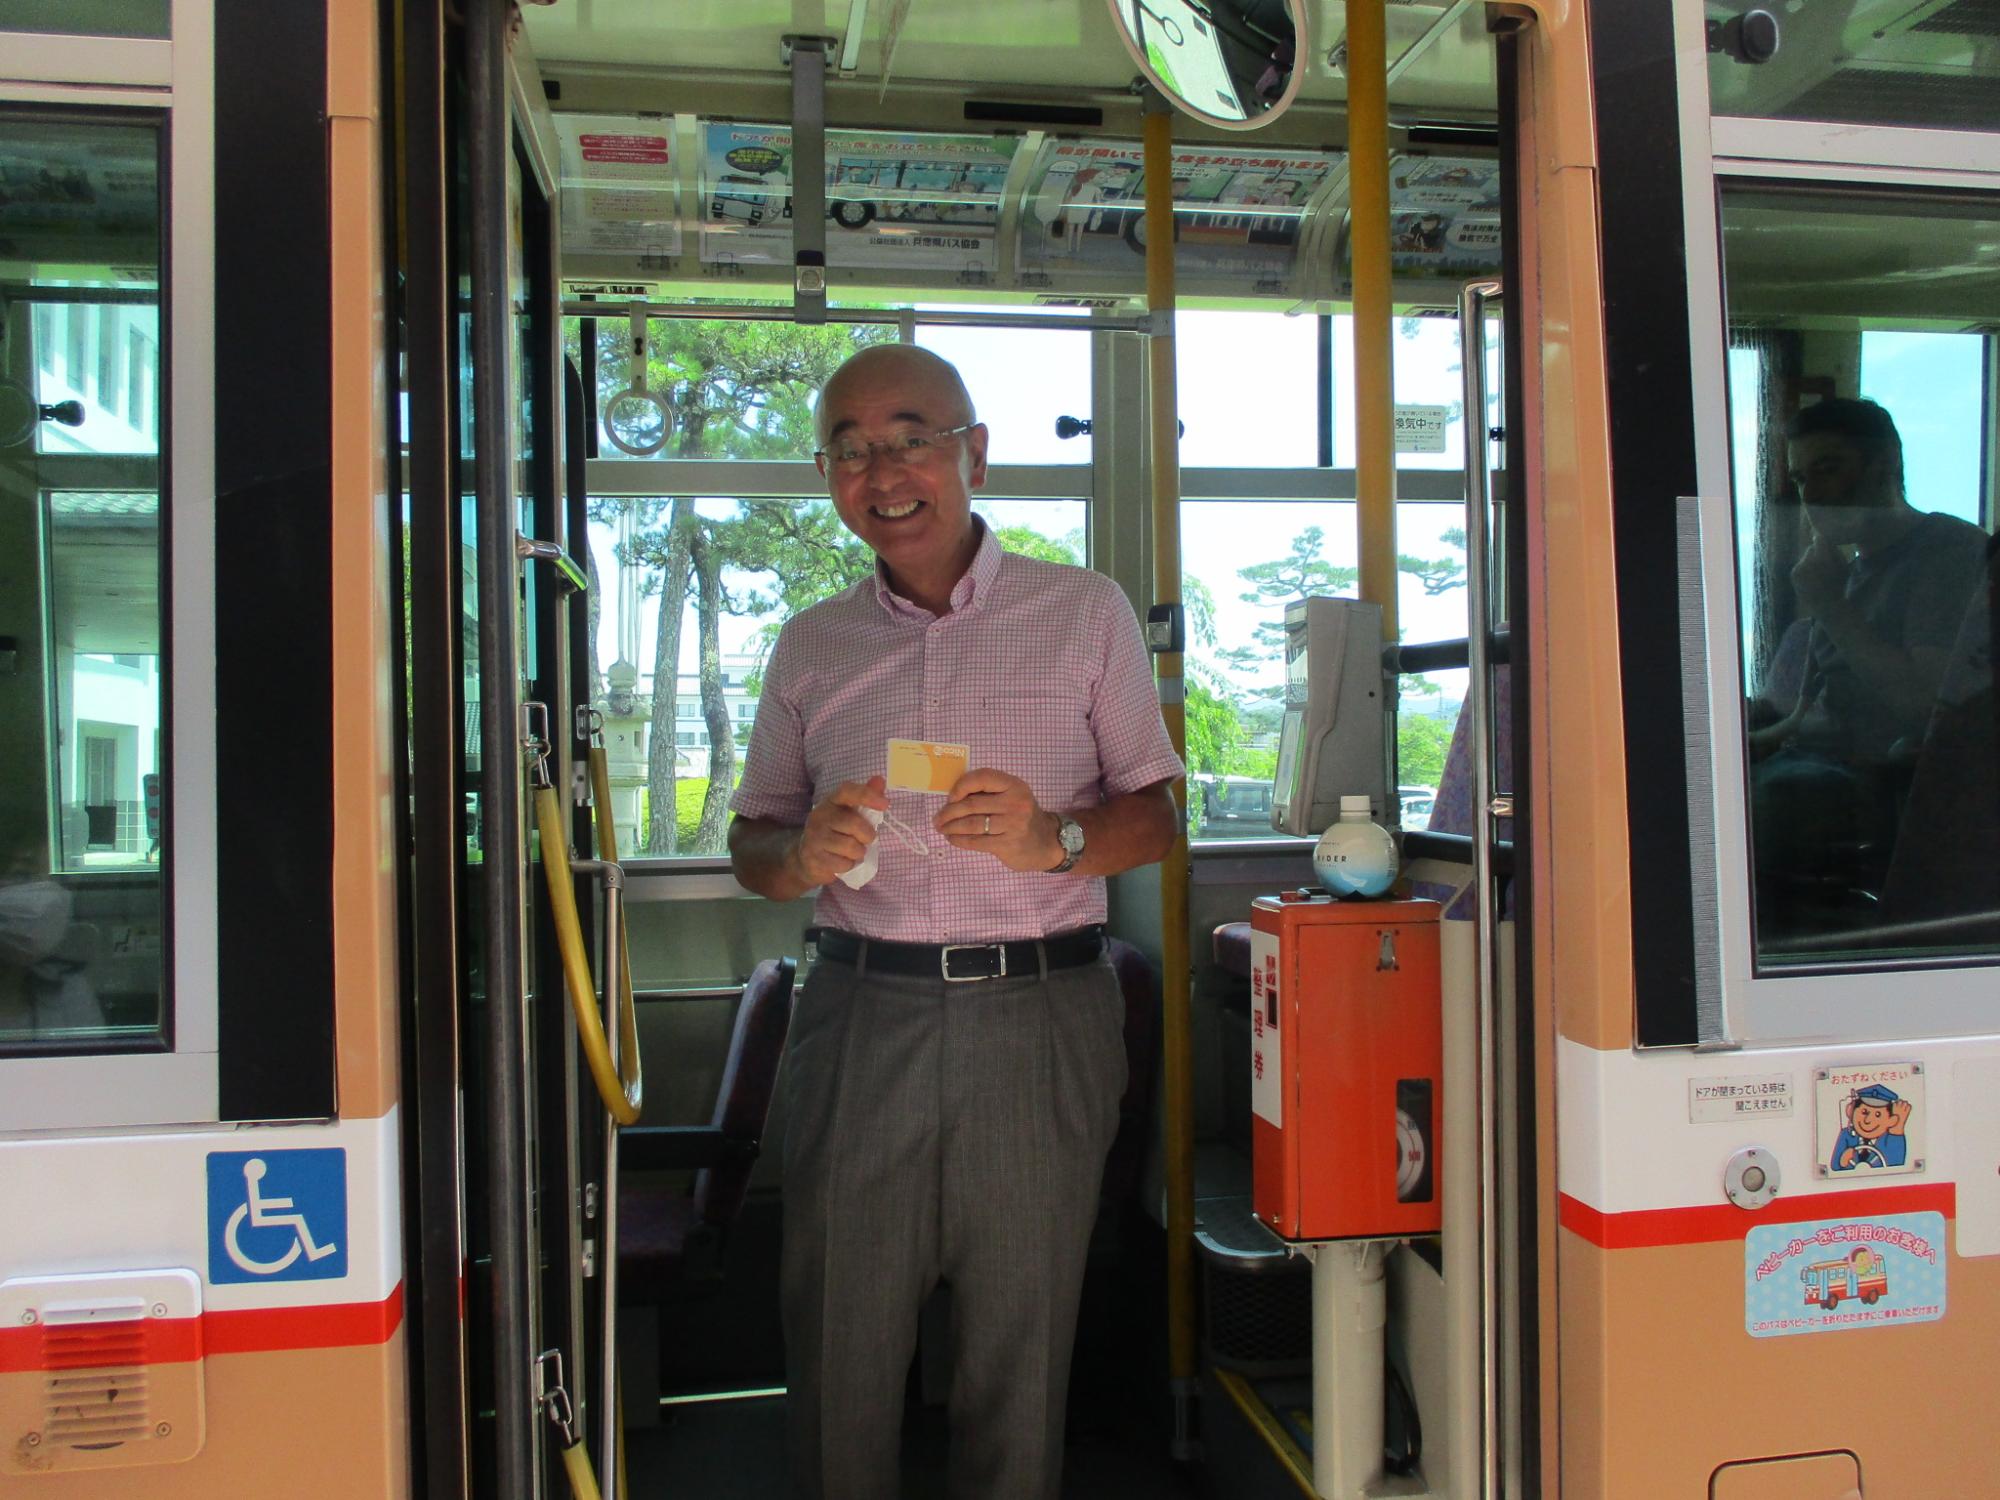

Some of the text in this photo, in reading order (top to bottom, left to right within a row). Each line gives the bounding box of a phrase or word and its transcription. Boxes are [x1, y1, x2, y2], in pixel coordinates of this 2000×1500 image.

[1253, 967, 1264, 1081] 整理券
[1831, 1071, 1909, 1085] おたずねください
[1695, 1083, 1787, 1098] ドアが閉まっている時は
[1735, 1098, 1787, 1111] 聞こえません
[1755, 1224, 1936, 1281] ベビーカーをご利用のお客様へ
